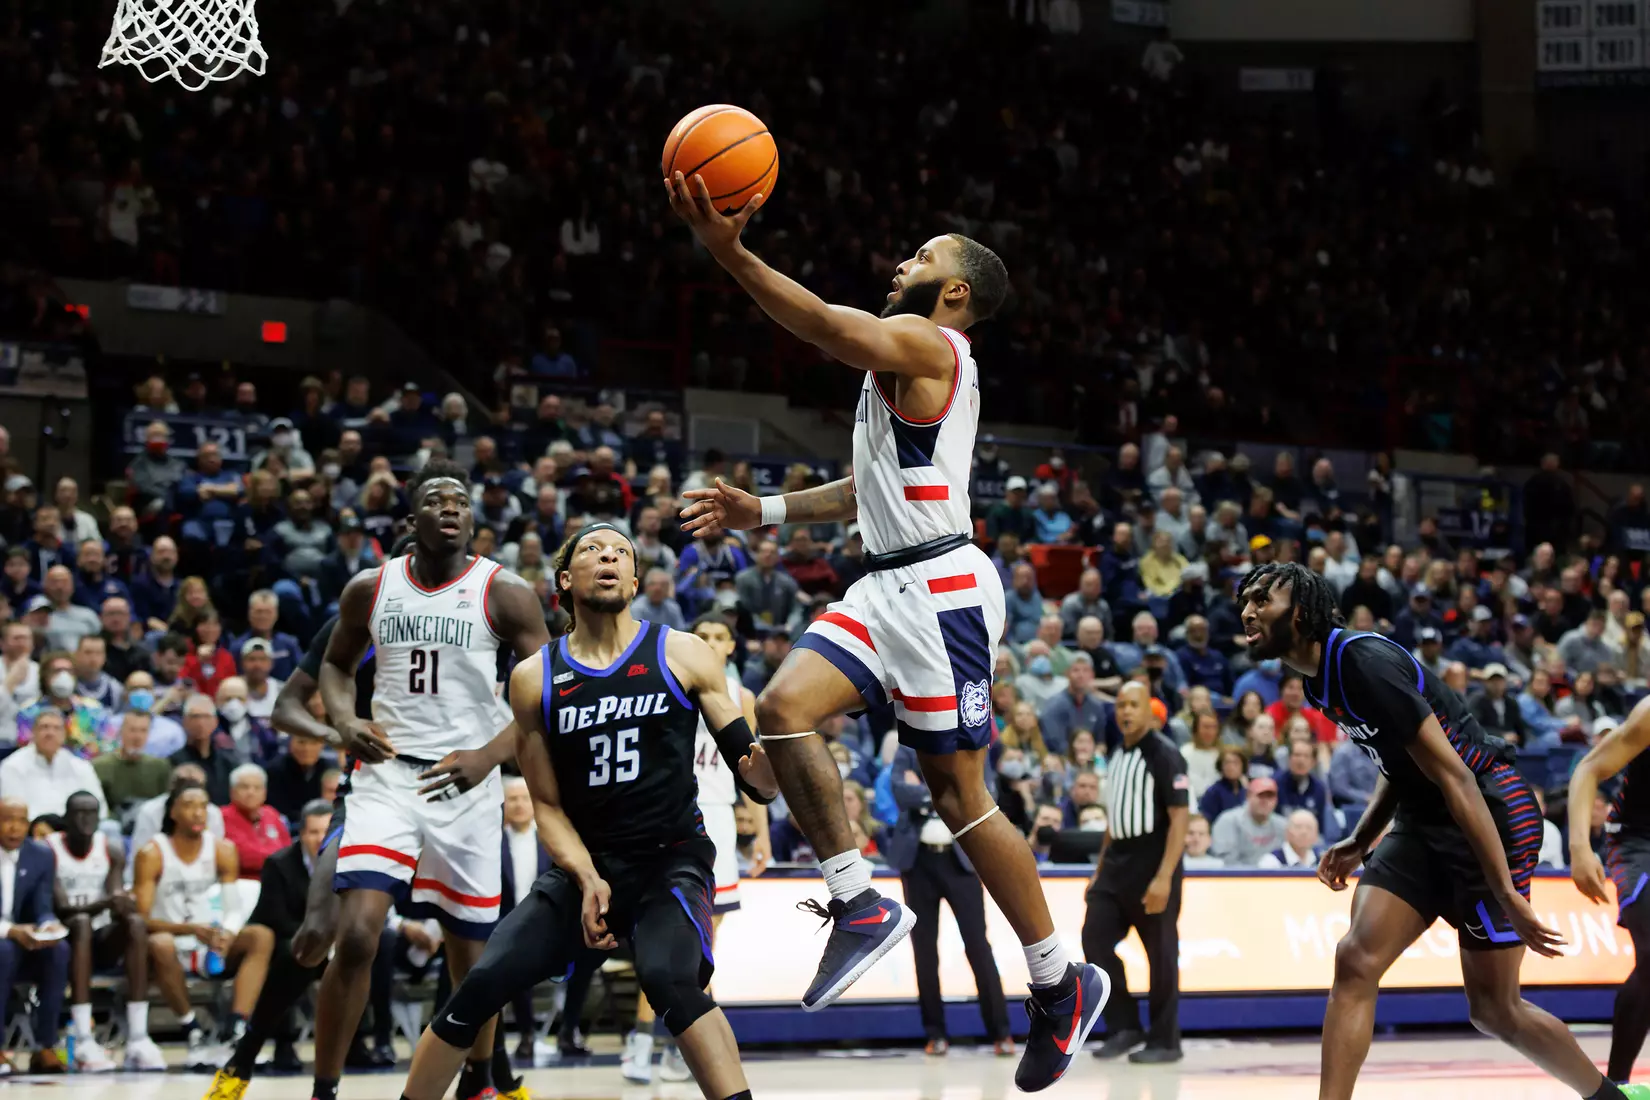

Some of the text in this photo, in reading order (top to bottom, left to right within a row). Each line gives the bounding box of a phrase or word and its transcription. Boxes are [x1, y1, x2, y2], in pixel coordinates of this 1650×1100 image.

[379, 615, 473, 648] CONNECTICUT
[409, 649, 439, 694] 21
[589, 727, 640, 786] 35
[696, 742, 719, 771] 44
